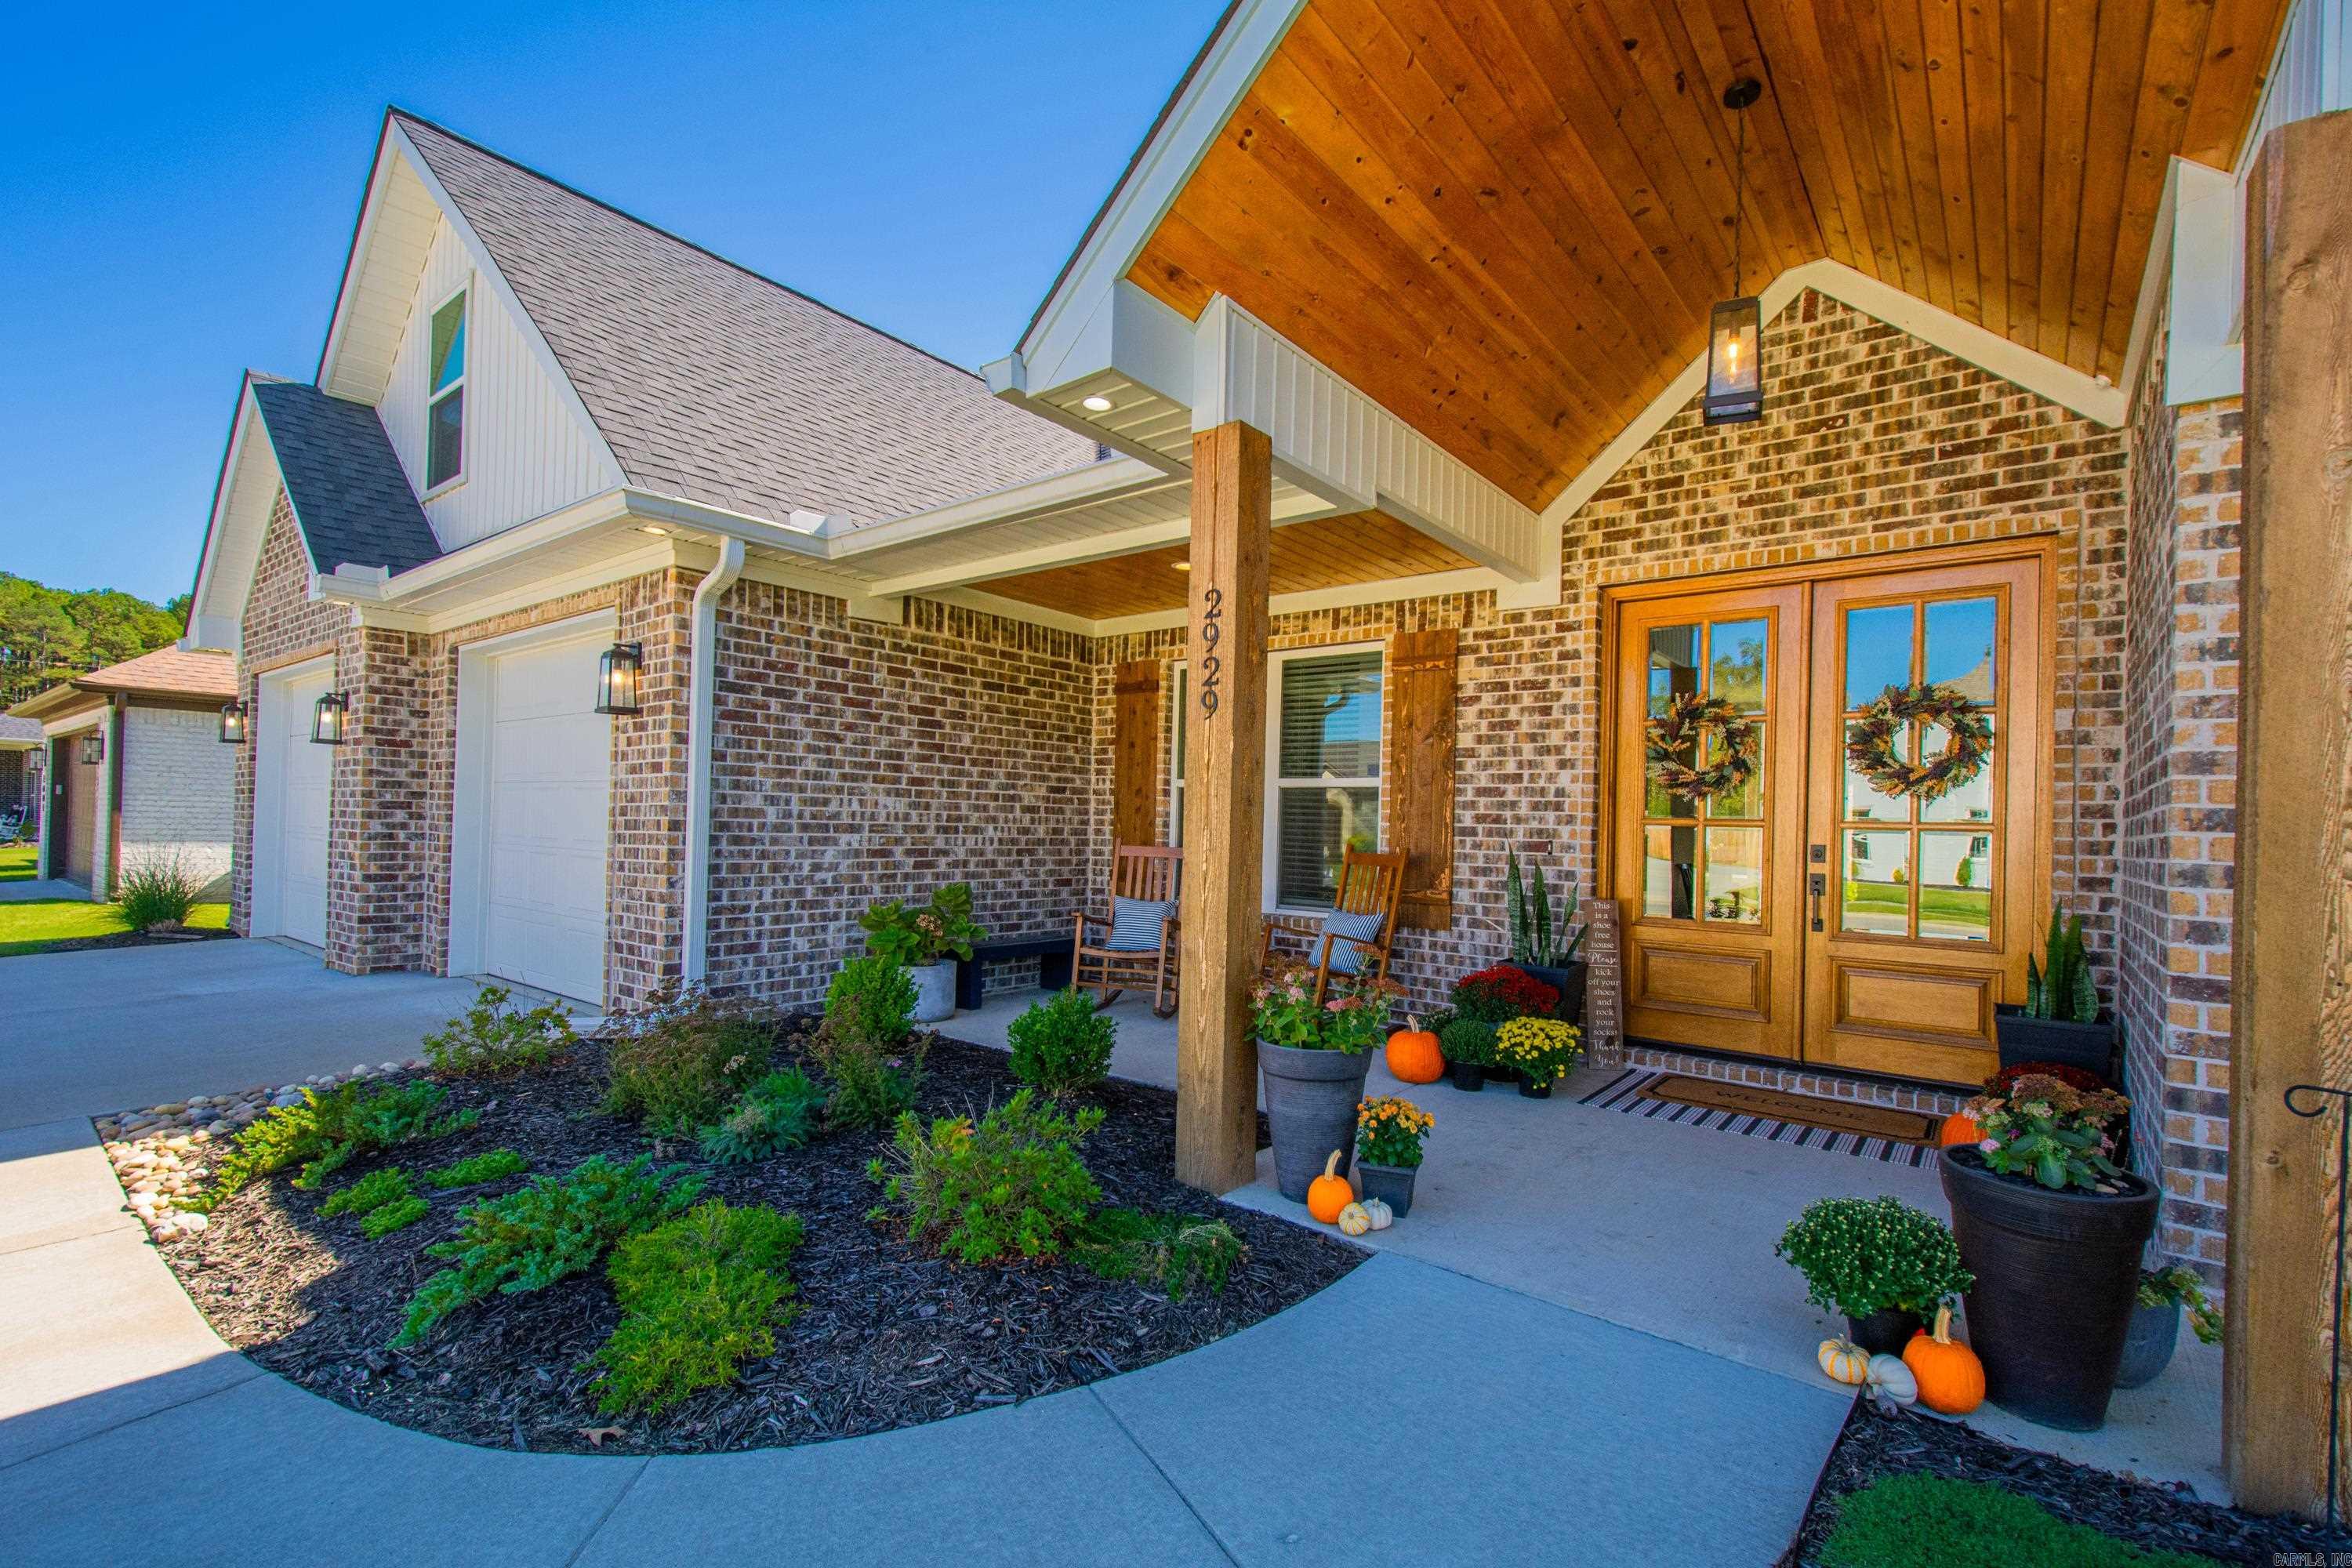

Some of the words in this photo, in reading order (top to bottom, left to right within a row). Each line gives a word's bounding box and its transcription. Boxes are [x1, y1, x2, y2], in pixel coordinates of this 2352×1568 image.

[1200, 588, 1222, 720] 2929
[1588, 952, 1618, 964] Please
[1595, 1019, 1615, 1028] your
[1592, 1039, 1620, 1051] Thank
[1717, 1090, 1865, 1121] WELCOME
